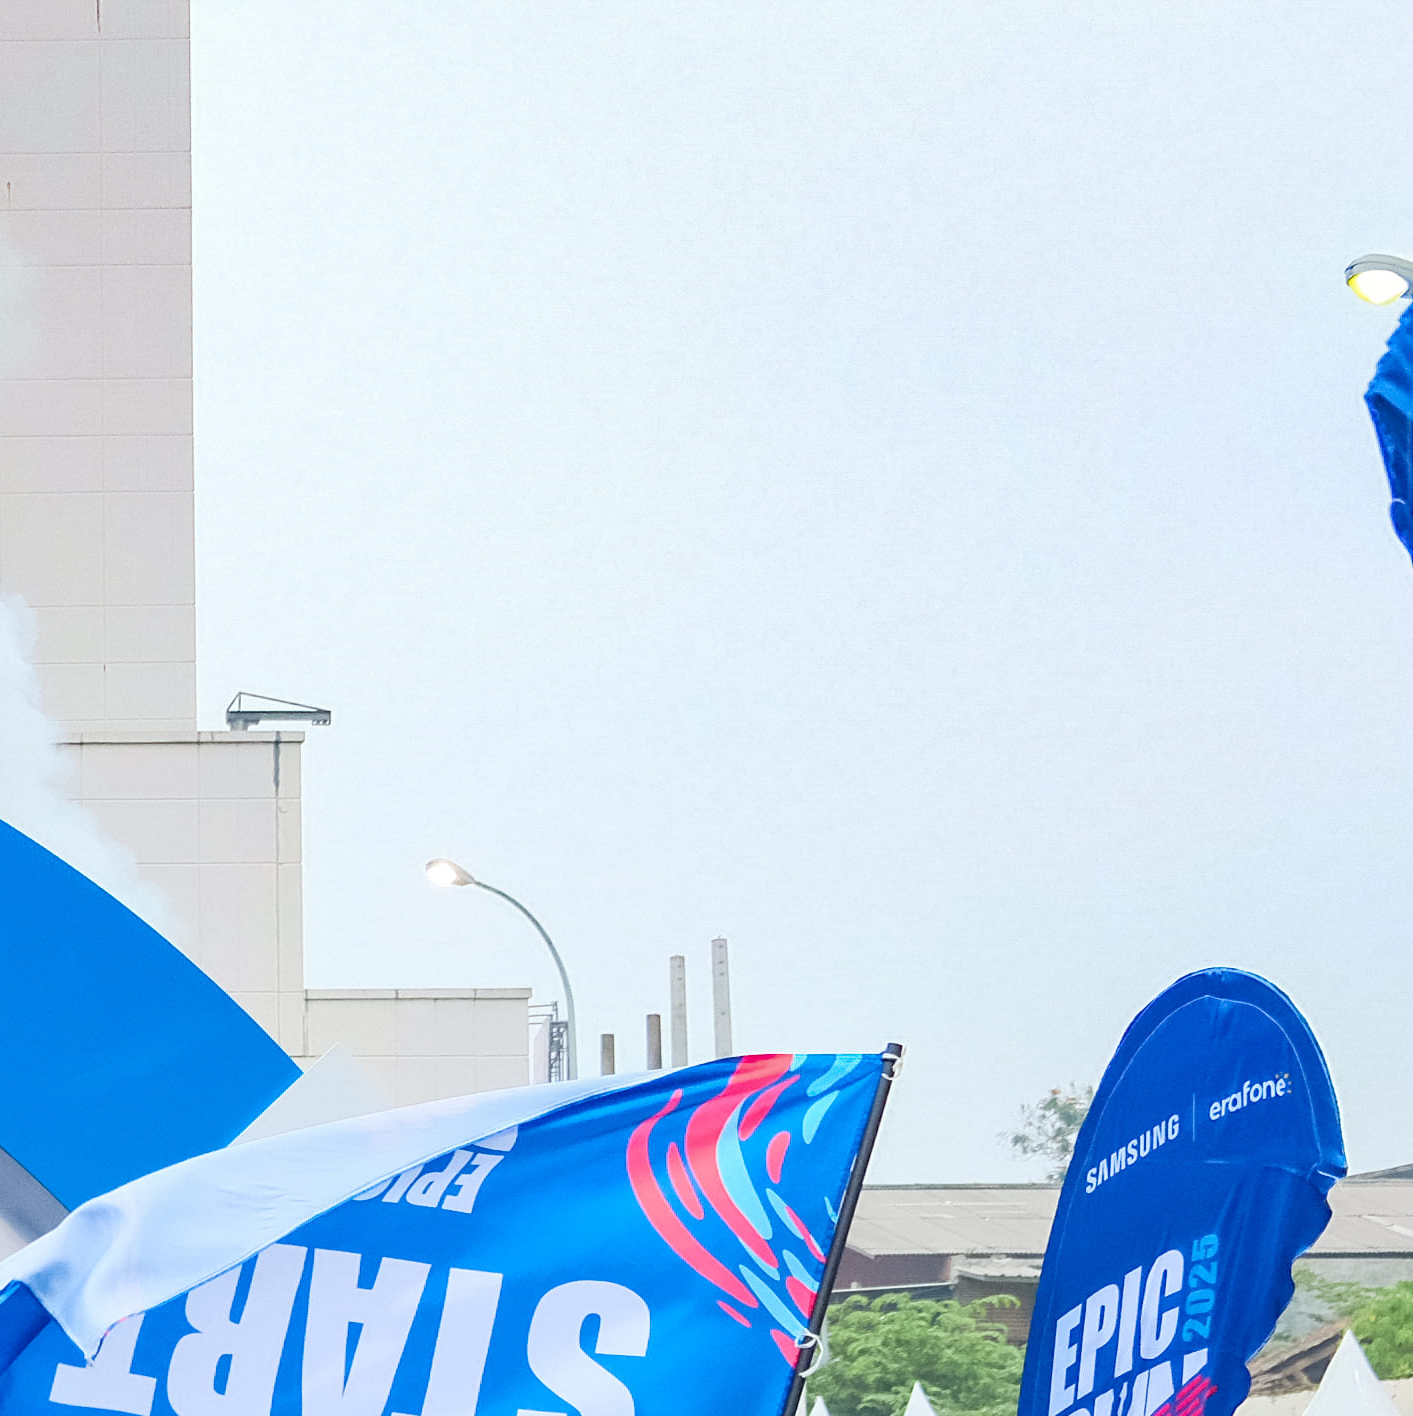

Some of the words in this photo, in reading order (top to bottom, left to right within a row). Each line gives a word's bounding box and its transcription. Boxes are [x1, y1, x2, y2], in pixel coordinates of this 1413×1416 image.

[1085, 1113, 1180, 1193] SAMSUNG
[1209, 1072, 1291, 1121] erafone
[1182, 1233, 1219, 1344] 2025
